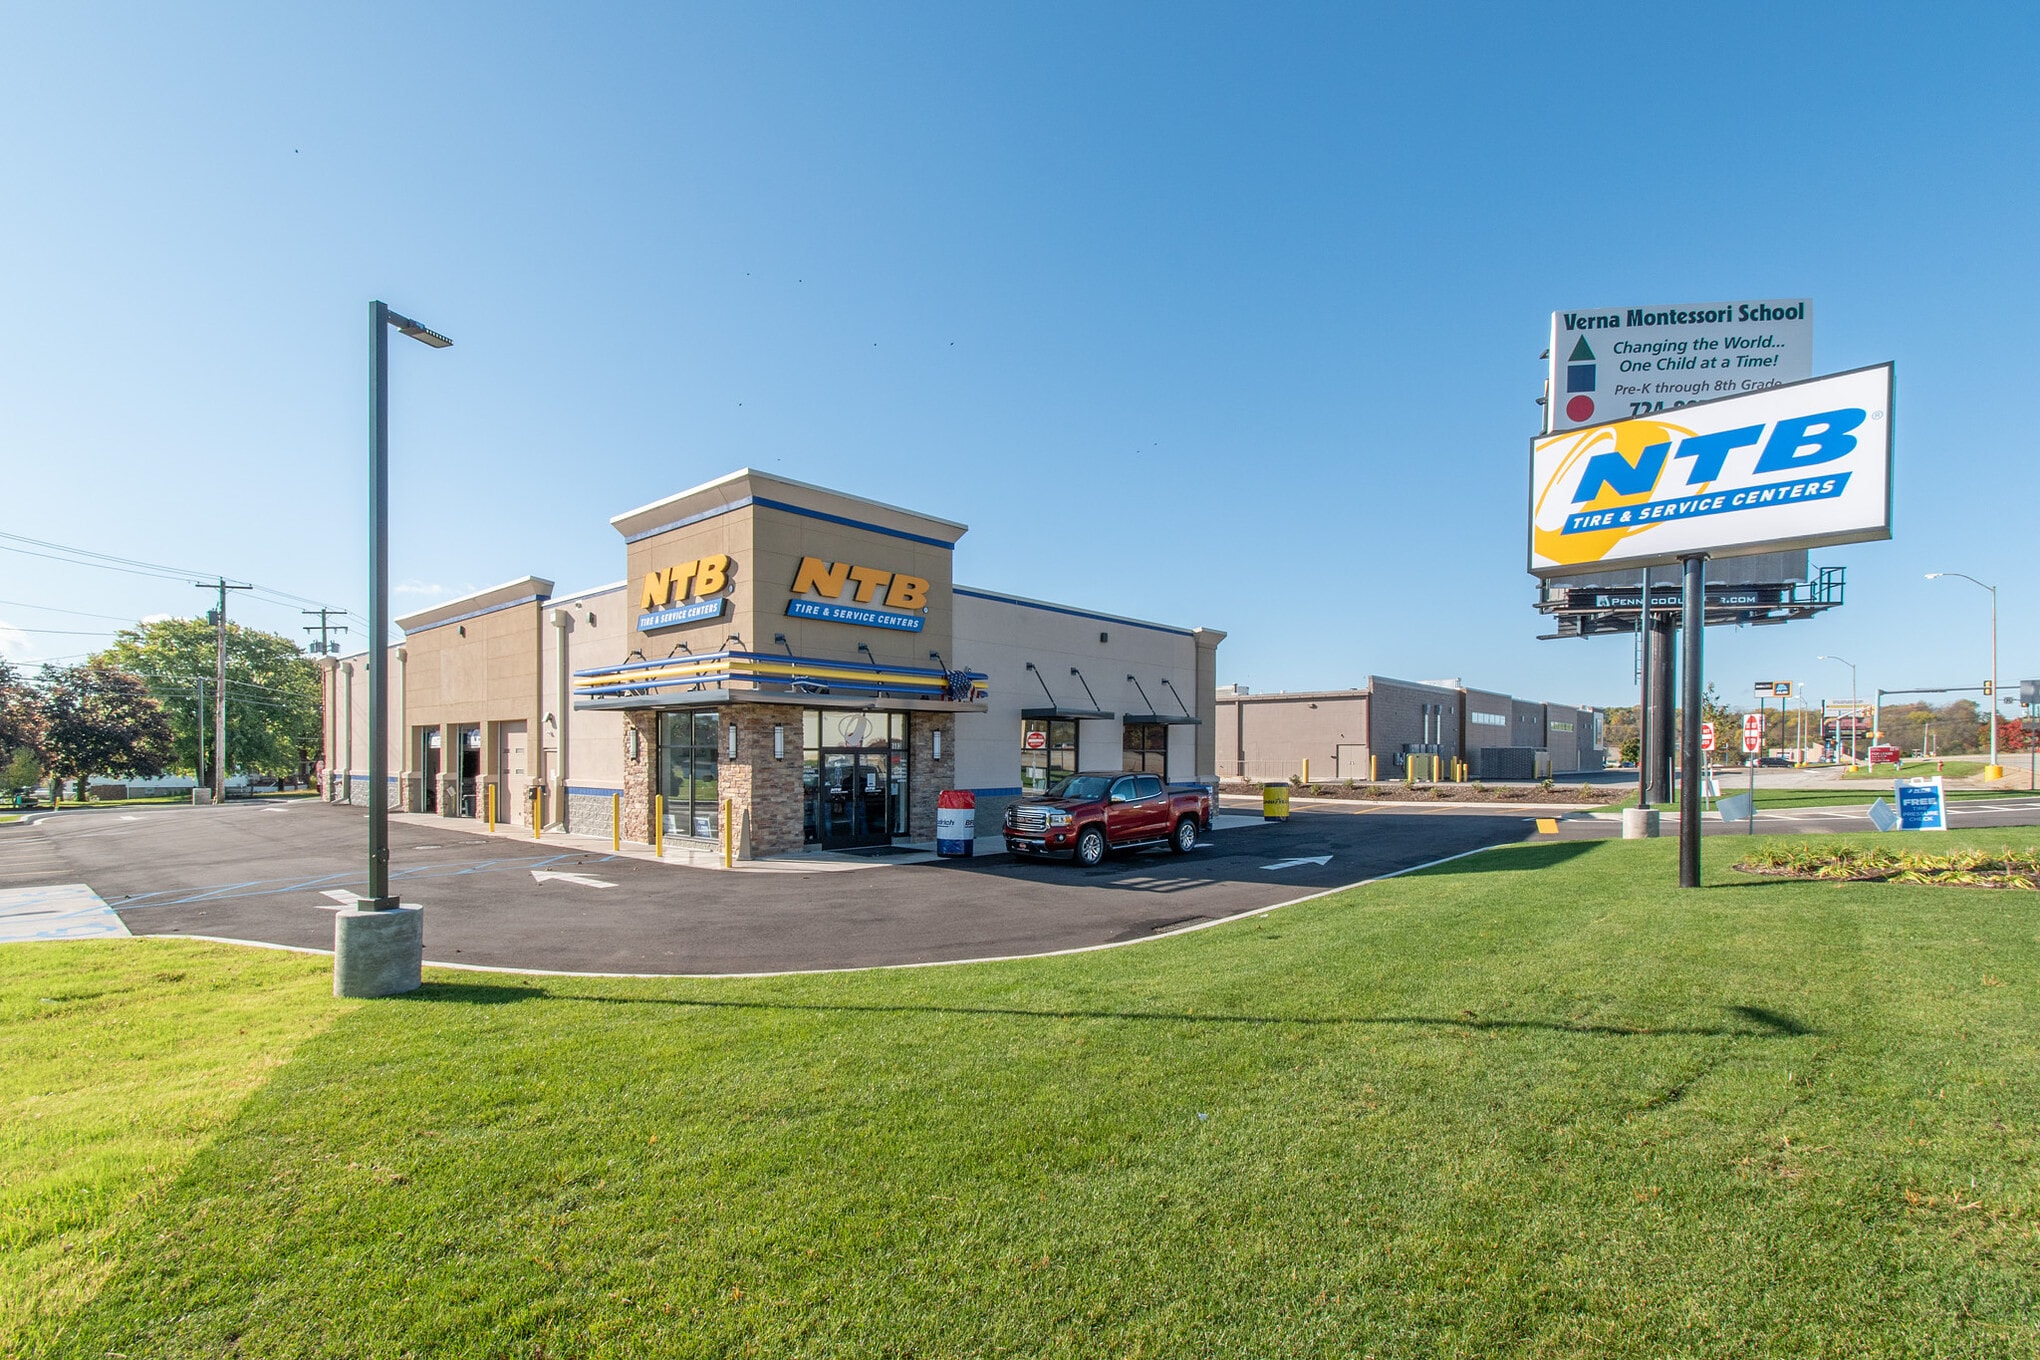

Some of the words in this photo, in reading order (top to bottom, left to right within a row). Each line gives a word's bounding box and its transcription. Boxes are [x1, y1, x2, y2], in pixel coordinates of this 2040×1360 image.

[1563, 313, 1620, 331] Verna
[1626, 305, 1733, 327] Montessori
[1738, 302, 1805, 322] School
[1613, 339, 1688, 356] Changing
[1693, 337, 1718, 351] the
[1724, 335, 1785, 349] World...
[1620, 360, 1651, 372] One
[1656, 356, 1697, 371] Child
[1700, 356, 1717, 369] at
[1721, 358, 1730, 368] a
[1736, 354, 1779, 368] Time!
[1614, 383, 1652, 395] Pre-K
[1655, 380, 1710, 395] through
[1713, 379, 1736, 391] 8th
[1571, 408, 1867, 504] NTB
[1572, 512, 1615, 529] TIRE
[1619, 511, 1632, 523] &
[1638, 495, 1723, 520] SERVICE
[1731, 479, 1836, 506] CENTERS
[640, 553, 729, 609] NTB
[791, 556, 930, 609] NTB
[640, 616, 654, 627] TIRE
[660, 609, 686, 623] SERVICE
[687, 603, 718, 617] CENTERS
[795, 603, 820, 615] TIRE
[822, 607, 829, 616] &
[833, 609, 875, 623] SERVICE
[878, 615, 919, 628] CENTERS
[1903, 797, 1937, 806] FREE
